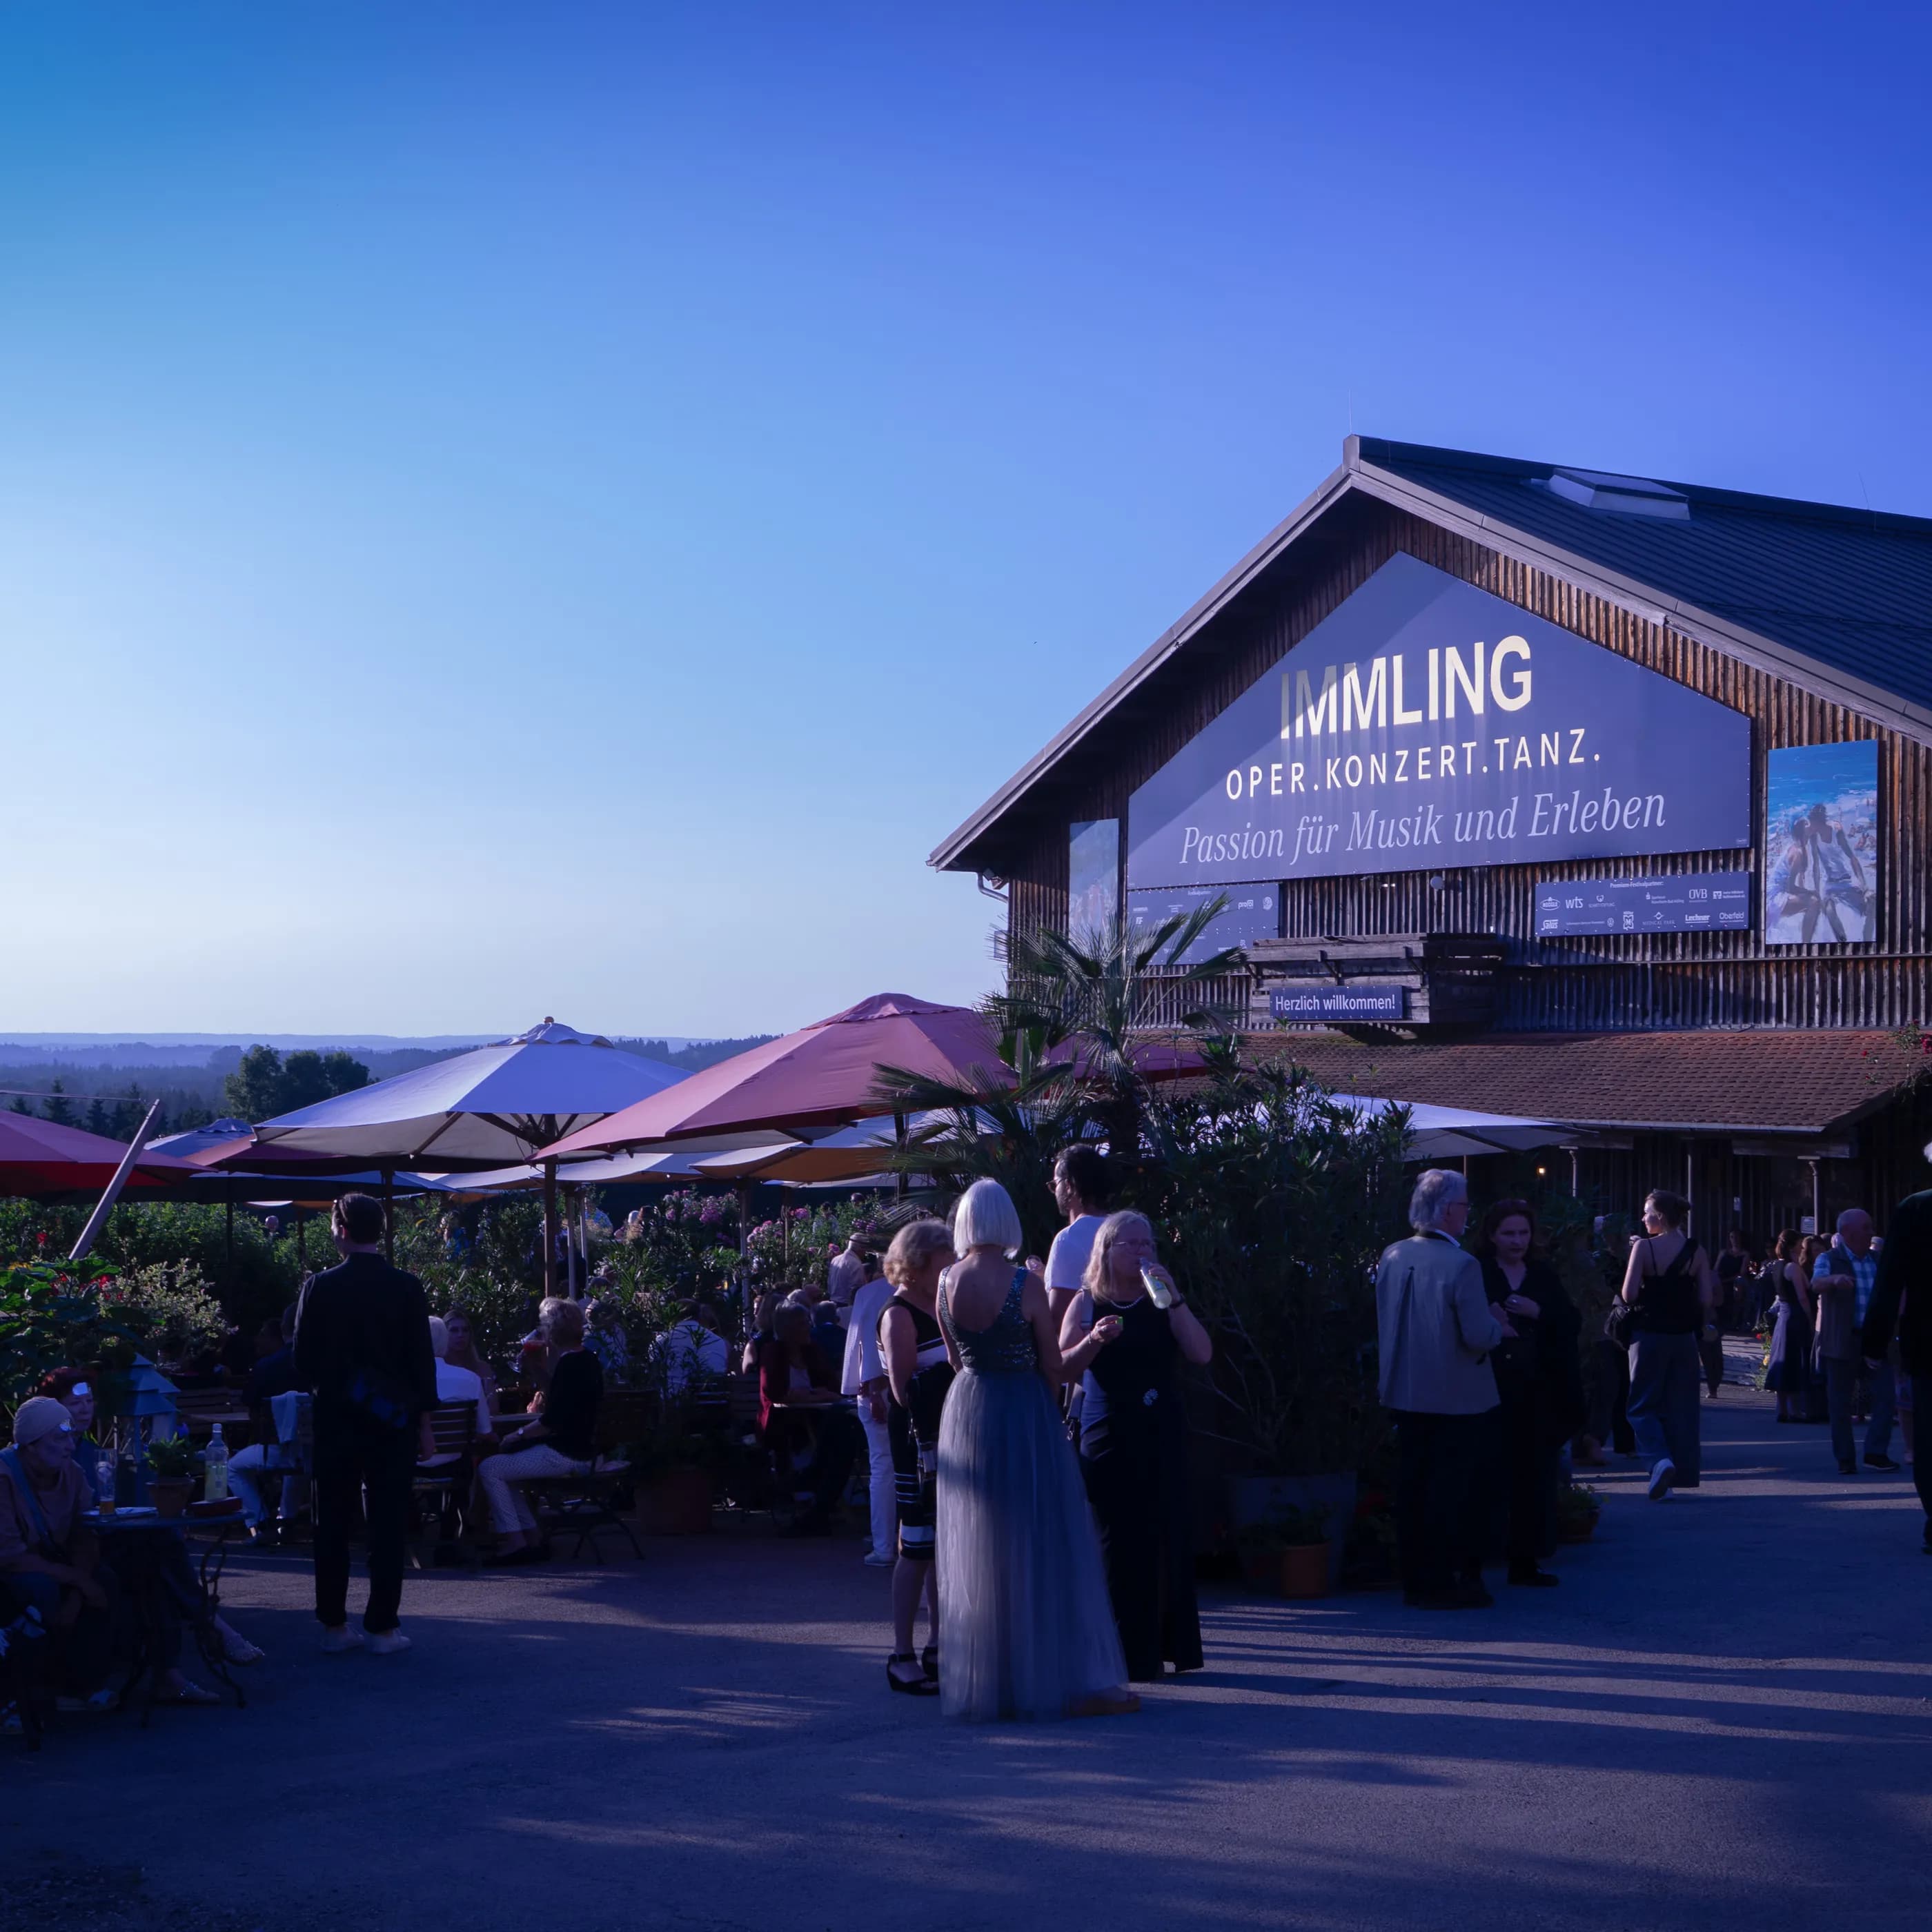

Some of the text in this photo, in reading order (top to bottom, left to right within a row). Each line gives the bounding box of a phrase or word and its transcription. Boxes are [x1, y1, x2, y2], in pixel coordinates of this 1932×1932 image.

[1281, 635, 1531, 740] IMMLING
[1179, 787, 1666, 865] Passion für Musik und Erleben
[1688, 889, 1708, 899] OVB
[1275, 994, 1395, 1011] Herzlich willkommen!
